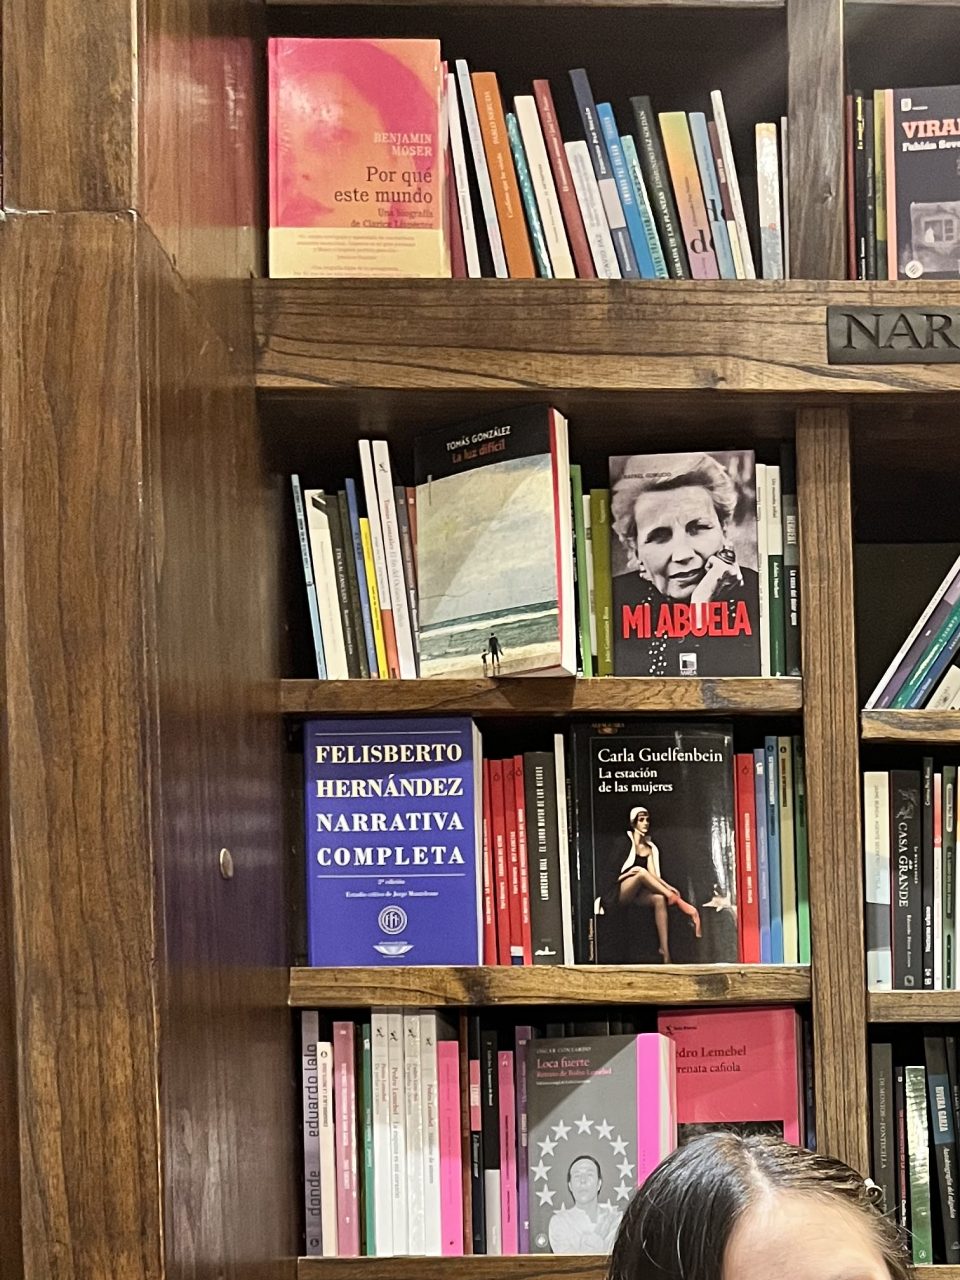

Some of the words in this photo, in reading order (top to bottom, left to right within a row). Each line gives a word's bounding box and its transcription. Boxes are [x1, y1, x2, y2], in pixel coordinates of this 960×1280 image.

[374, 133, 433, 145] BENJAMIN
[902, 140, 937, 152] Fabián
[392, 145, 433, 157] MOSER
[366, 166, 396, 183] Por
[401, 168, 432, 188] qué
[334, 188, 369, 202] este
[375, 187, 433, 204] mundo
[446, 435, 470, 452] TOMÁS
[472, 425, 512, 444] GONZÁLEZ
[452, 452, 462, 464] La
[463, 448, 478, 462] luz
[622, 602, 650, 639] MI
[655, 601, 752, 638] ABUELA
[315, 743, 463, 764] FELISBERTO
[597, 748, 635, 763] Carla
[638, 746, 723, 763] Guelfenbein
[598, 768, 612, 779] La
[614, 767, 658, 779] estación
[315, 774, 464, 799] HERNÁNDEZ
[536, 788, 544, 798] LOS
[598, 781, 612, 793] de
[614, 780, 629, 793] las
[631, 781, 673, 796] mujeres
[316, 812, 465, 832] NARRATIVA
[537, 808, 545, 826] MAYOR
[538, 828, 546, 843] LIBRO
[898, 822, 908, 852] CASA
[317, 846, 466, 866] COMPLETA
[539, 872, 548, 900] LAWRENCE
[898, 855, 908, 907] GRANDE
[304, 1043, 317, 1071] lalo
[676, 1047, 699, 1058] edro
[701, 1045, 747, 1058] Lemebel
[536, 1058, 559, 1069] Loca
[560, 1057, 590, 1068] fuerte
[676, 1063, 708, 1073] renata
[709, 1062, 741, 1073] cafiola
[391, 1067, 399, 1087] Pedro
[305, 1076, 319, 1137] eduardo
[392, 1088, 400, 1115] Lemebel
[935, 1086, 946, 1109] RIVERA
[938, 1110, 948, 1132] GARZA
[307, 1170, 321, 1216] donde
[946, 1187, 954, 1195] del
